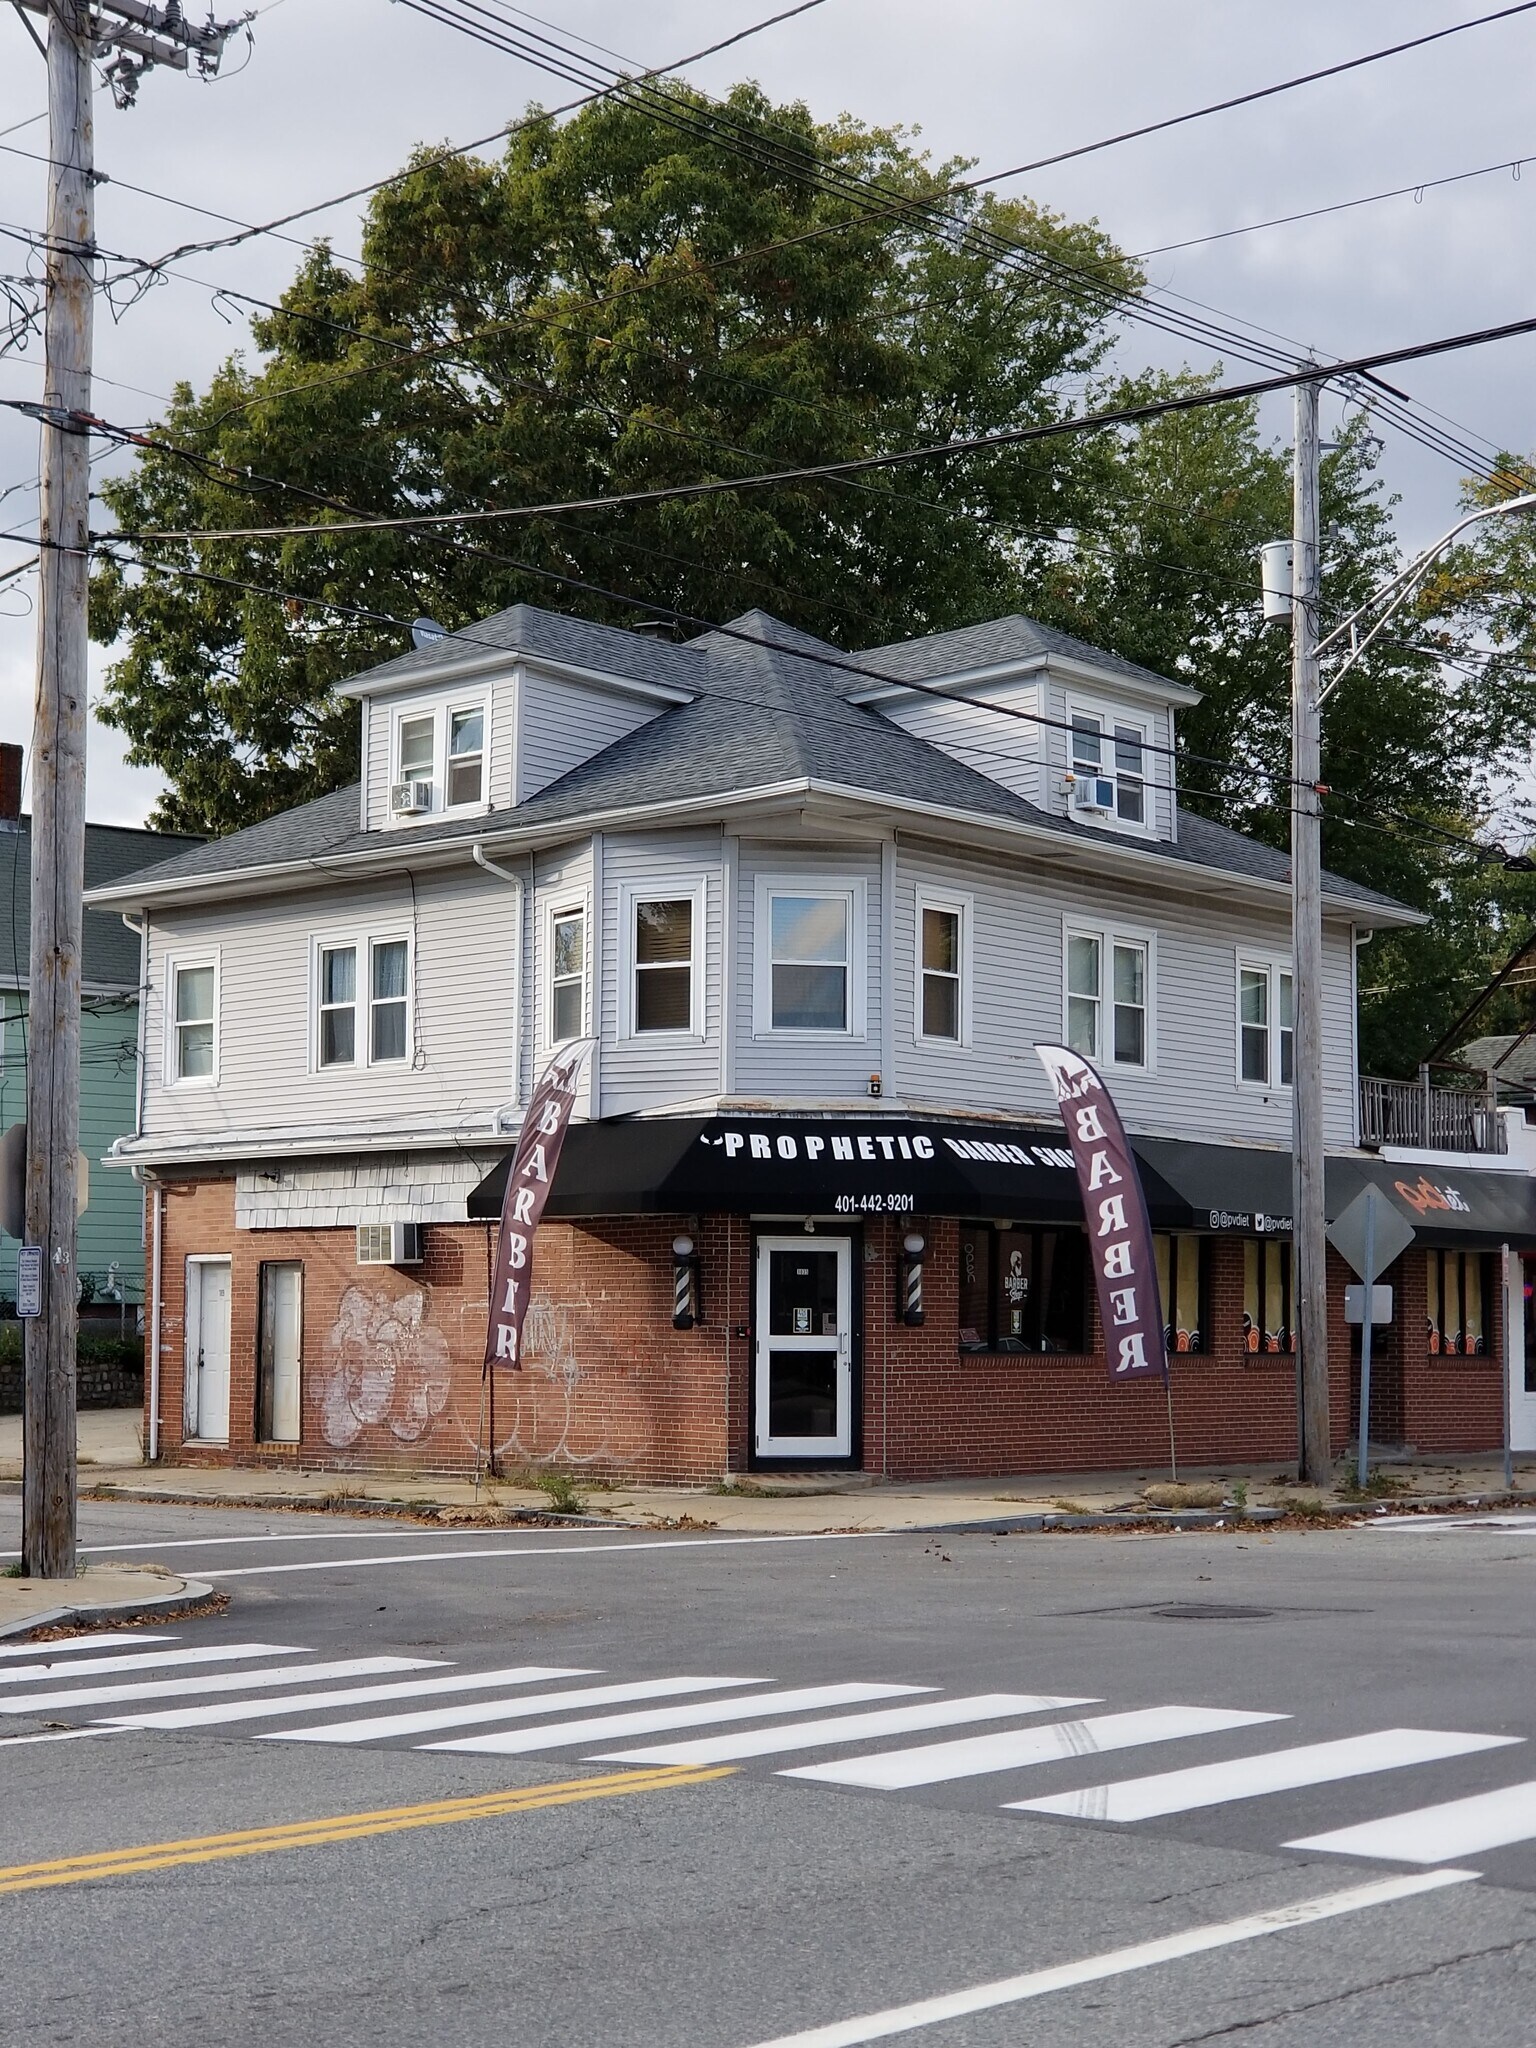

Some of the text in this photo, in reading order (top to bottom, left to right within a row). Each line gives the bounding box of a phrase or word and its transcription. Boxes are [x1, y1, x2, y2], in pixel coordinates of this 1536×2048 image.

[724, 1132, 1076, 1168] PROPHETIC BARBER SHO
[834, 1194, 914, 1212] 401-442-9201
[1220, 1212, 1250, 1228] @pvdiet
[53, 1247, 70, 1264] 43
[1004, 1277, 1028, 1290] BARBER
